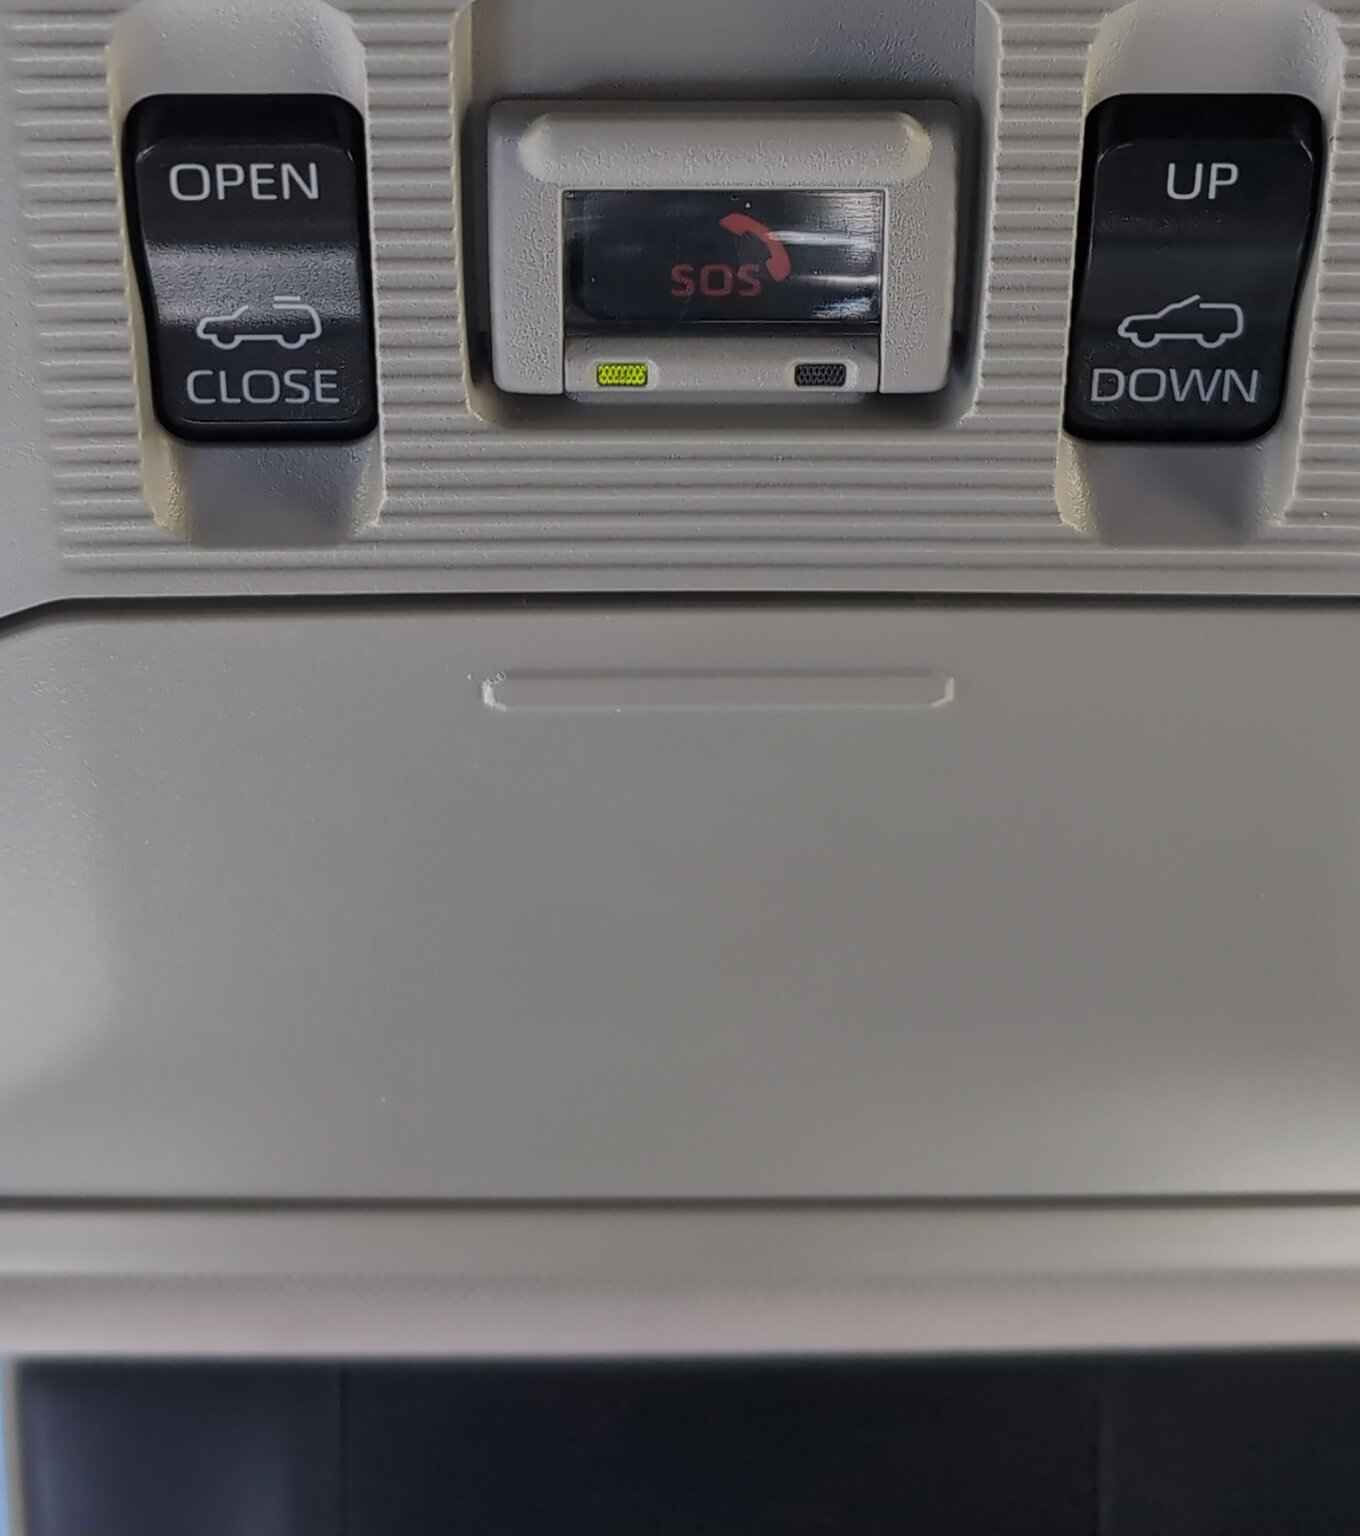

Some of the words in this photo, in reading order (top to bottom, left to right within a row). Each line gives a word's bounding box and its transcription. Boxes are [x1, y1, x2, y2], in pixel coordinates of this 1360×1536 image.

[168, 162, 320, 201] OPEN
[1166, 162, 1239, 200] UP
[670, 263, 763, 299] SOS
[186, 369, 340, 404] CLOSE
[1090, 368, 1259, 403] DOWN
